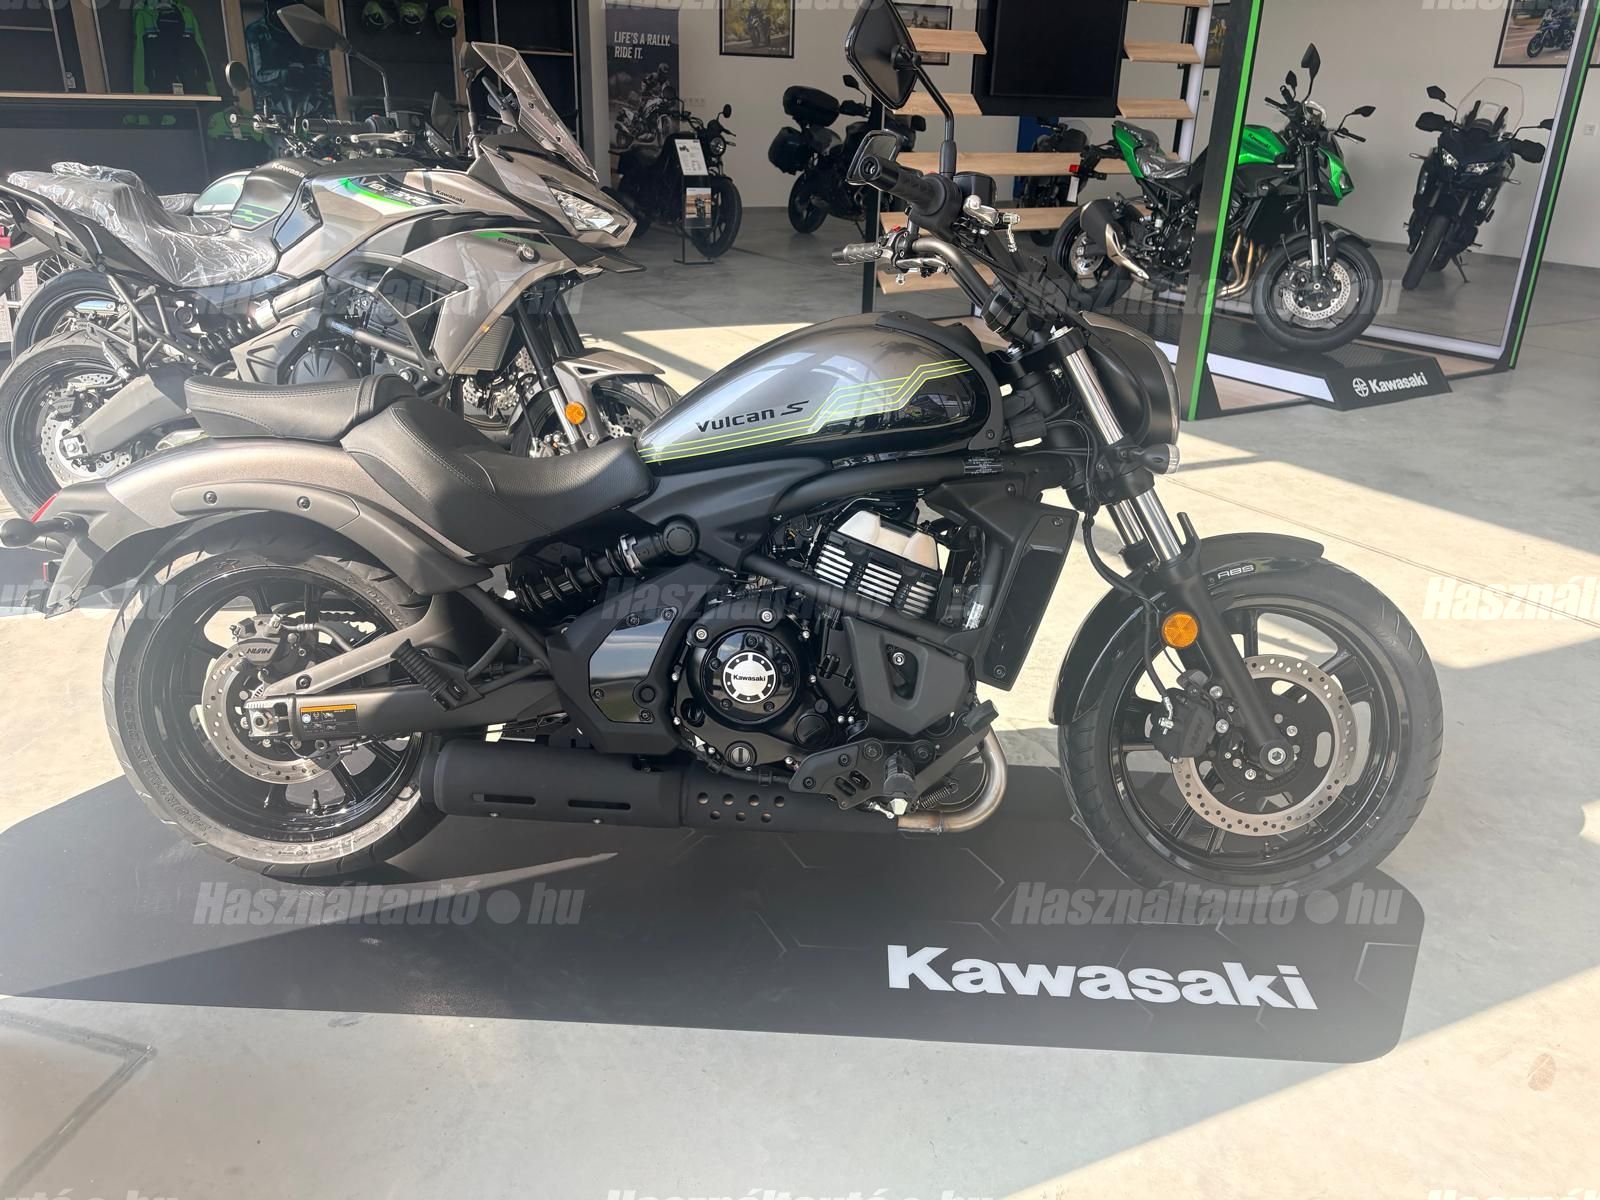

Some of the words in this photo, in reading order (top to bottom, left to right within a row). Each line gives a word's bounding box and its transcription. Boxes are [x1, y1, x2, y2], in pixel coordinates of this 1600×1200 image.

[614, 31, 639, 45] LIFE'S
[640, 33, 645, 45] A
[647, 34, 671, 47] RALLY.
[614, 47, 632, 59] RIDE
[634, 47, 643, 59] IT.
[271, 161, 306, 178] Kawasa
[435, 189, 466, 204] Kawasaki
[1368, 372, 1429, 393] Kawasaki
[696, 408, 775, 432] Vulcan
[780, 400, 809, 416] S
[1217, 564, 1254, 580] ABS
[733, 674, 766, 682] Kawasaki
[887, 944, 1319, 1010] Kawasaki
